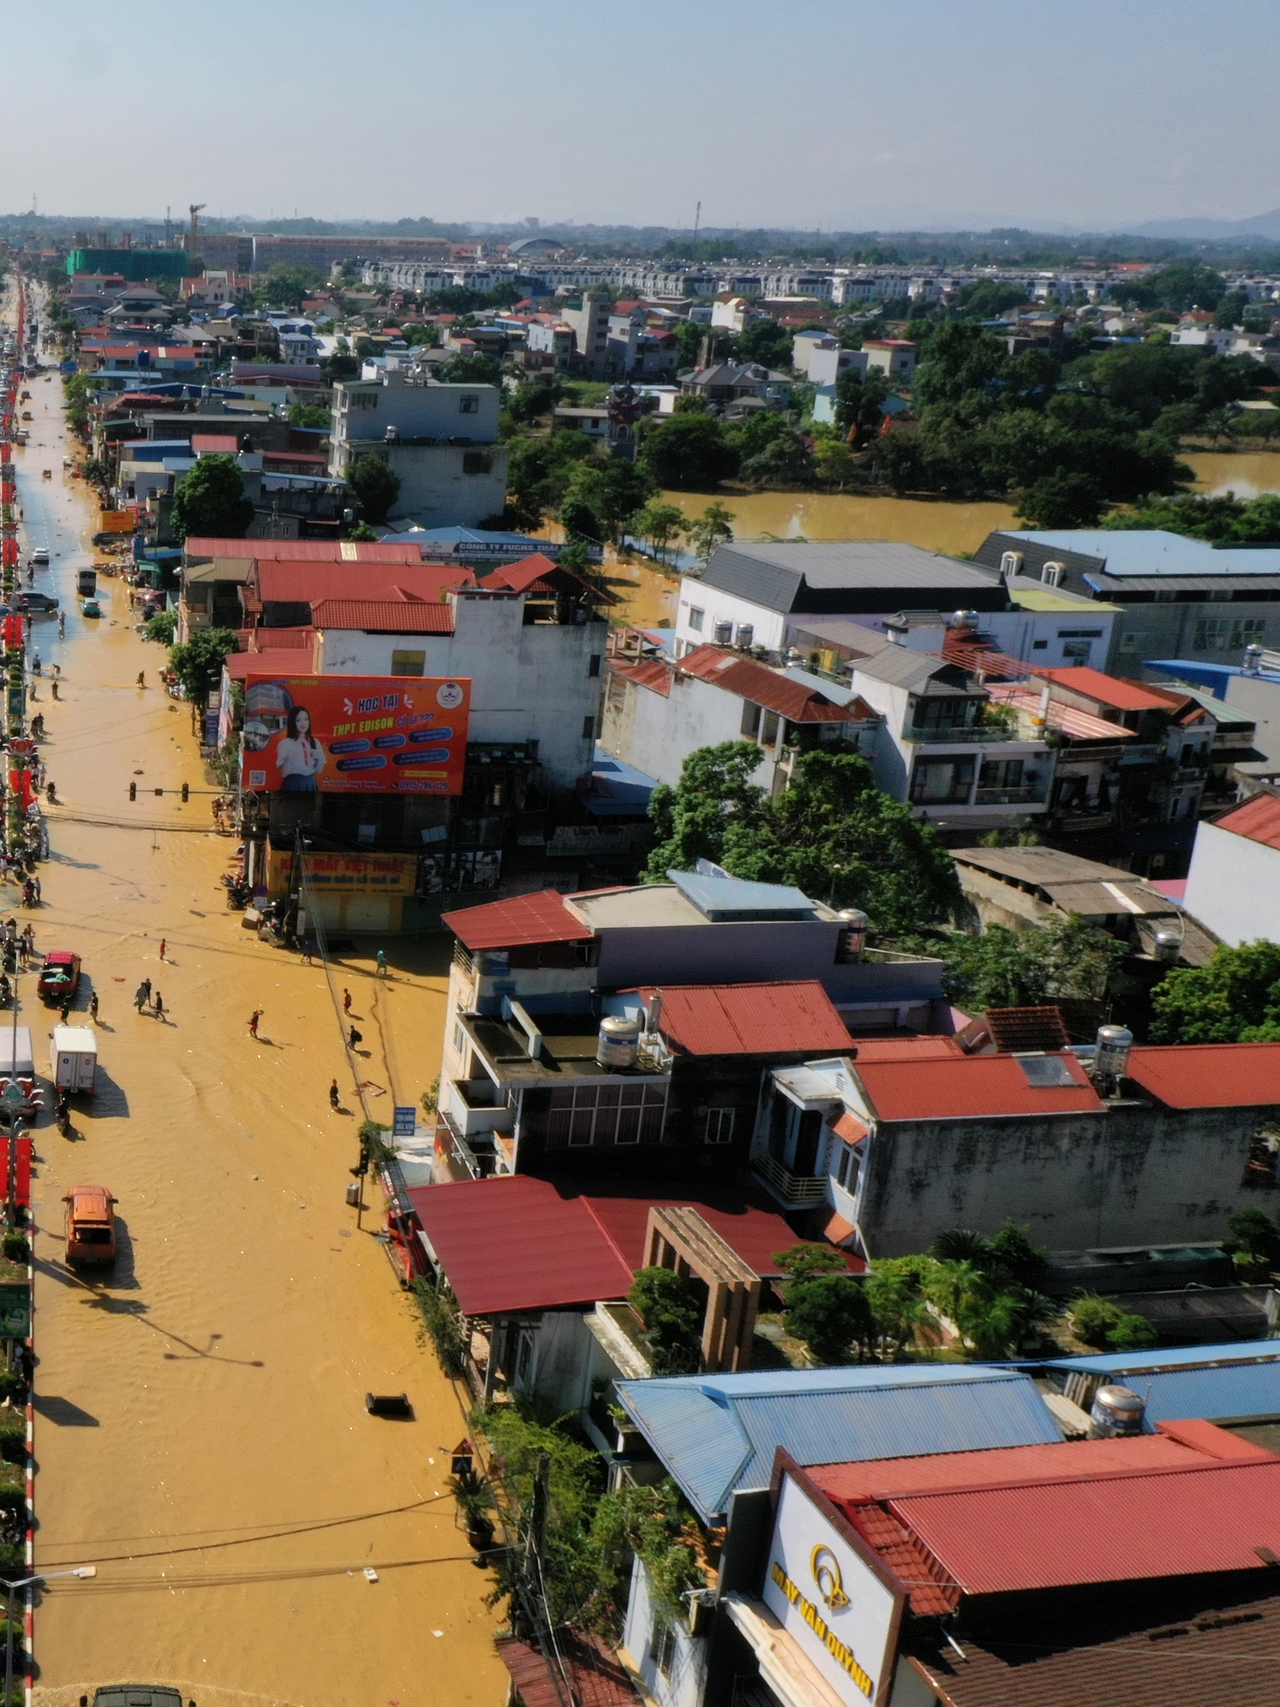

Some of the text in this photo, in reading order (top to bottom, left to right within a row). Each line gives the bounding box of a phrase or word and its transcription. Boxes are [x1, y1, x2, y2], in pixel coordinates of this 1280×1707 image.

[459, 542, 486, 551] CÔNG
[489, 543, 501, 551] TY
[503, 543, 534, 551] FUCHS
[357, 694, 399, 714] HỌC TẠI
[333, 722, 357, 737] THPT
[359, 717, 395, 733] EDISON
[399, 780, 418, 790] 0915
[418, 780, 434, 791] 286
[435, 781, 449, 792] 129
[771, 1562, 801, 1605] MAY
